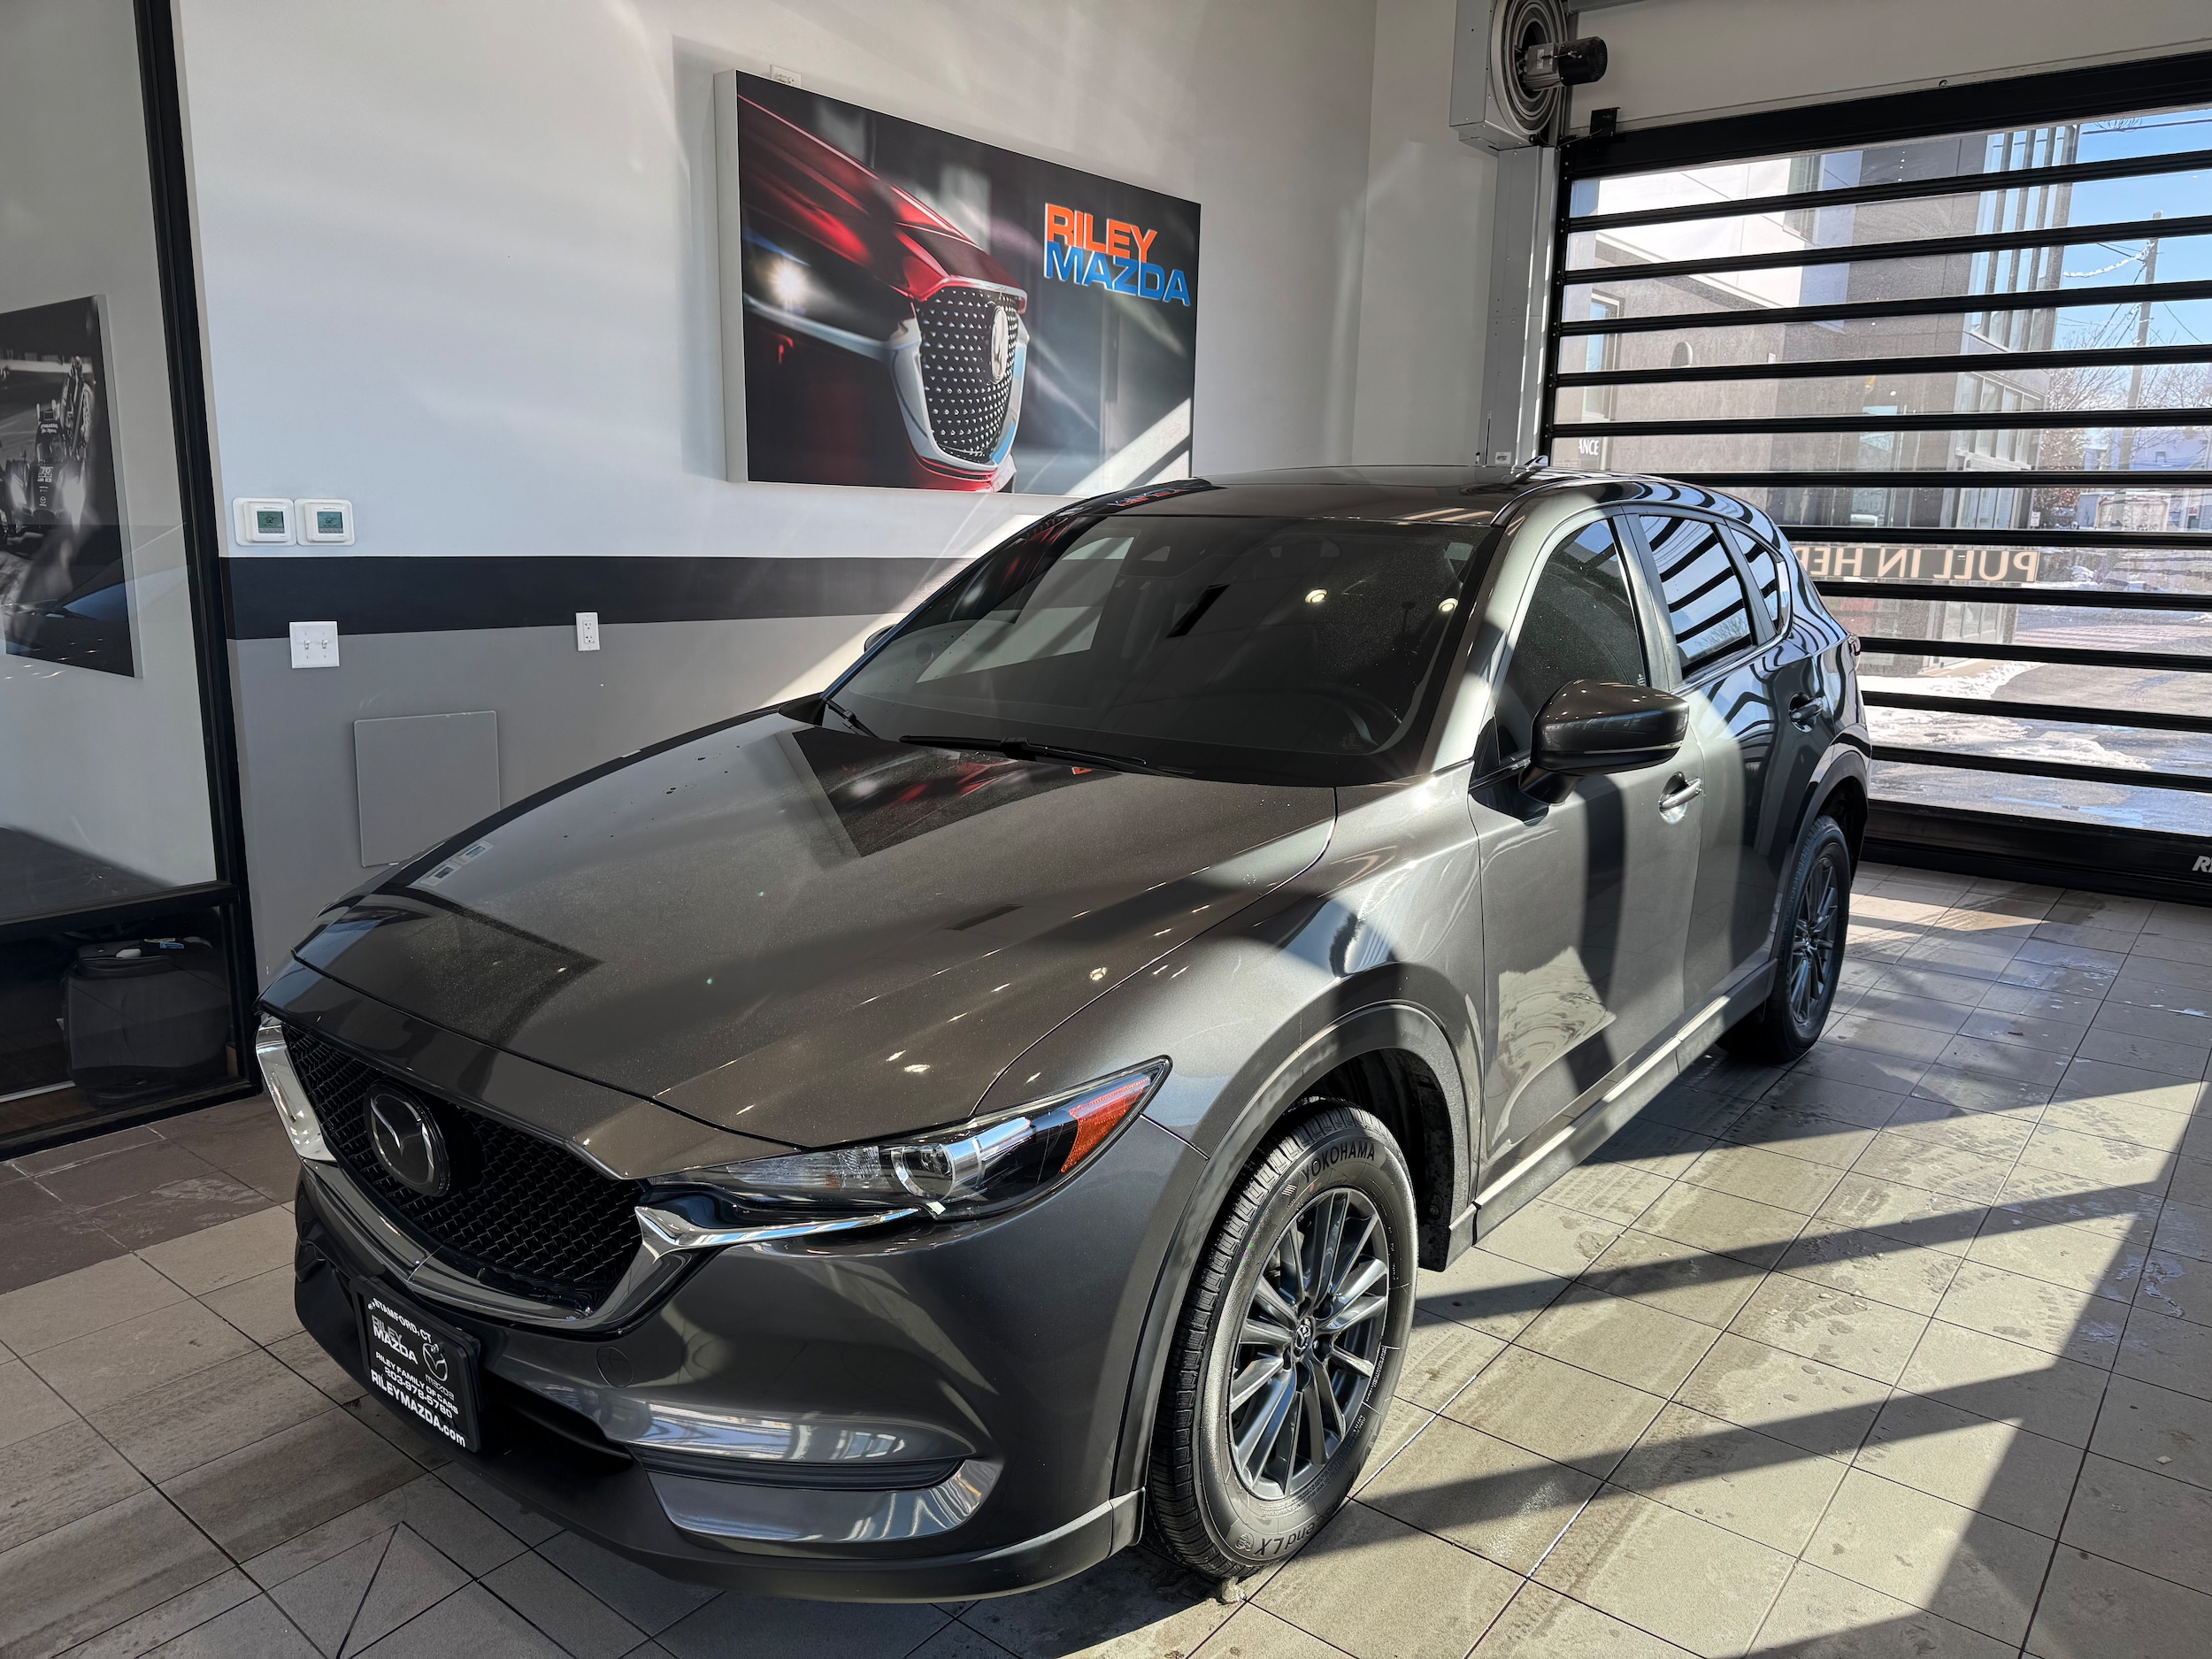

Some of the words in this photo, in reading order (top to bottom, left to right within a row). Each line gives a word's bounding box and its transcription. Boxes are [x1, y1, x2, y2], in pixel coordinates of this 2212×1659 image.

[1045, 203, 1158, 264] RILEY
[1043, 241, 1191, 306] MAZDA
[1302, 1140, 1375, 1184] YOKOHAMA
[372, 1315, 403, 1345] RILEY
[373, 1325, 419, 1364] MAZDA
[371, 1369, 466, 1448] RILEYMAZDA.com
[375, 1351, 396, 1371] RILEY
[396, 1366, 425, 1390] FAMILY
[426, 1386, 437, 1397] OF
[437, 1394, 458, 1415] CARS
